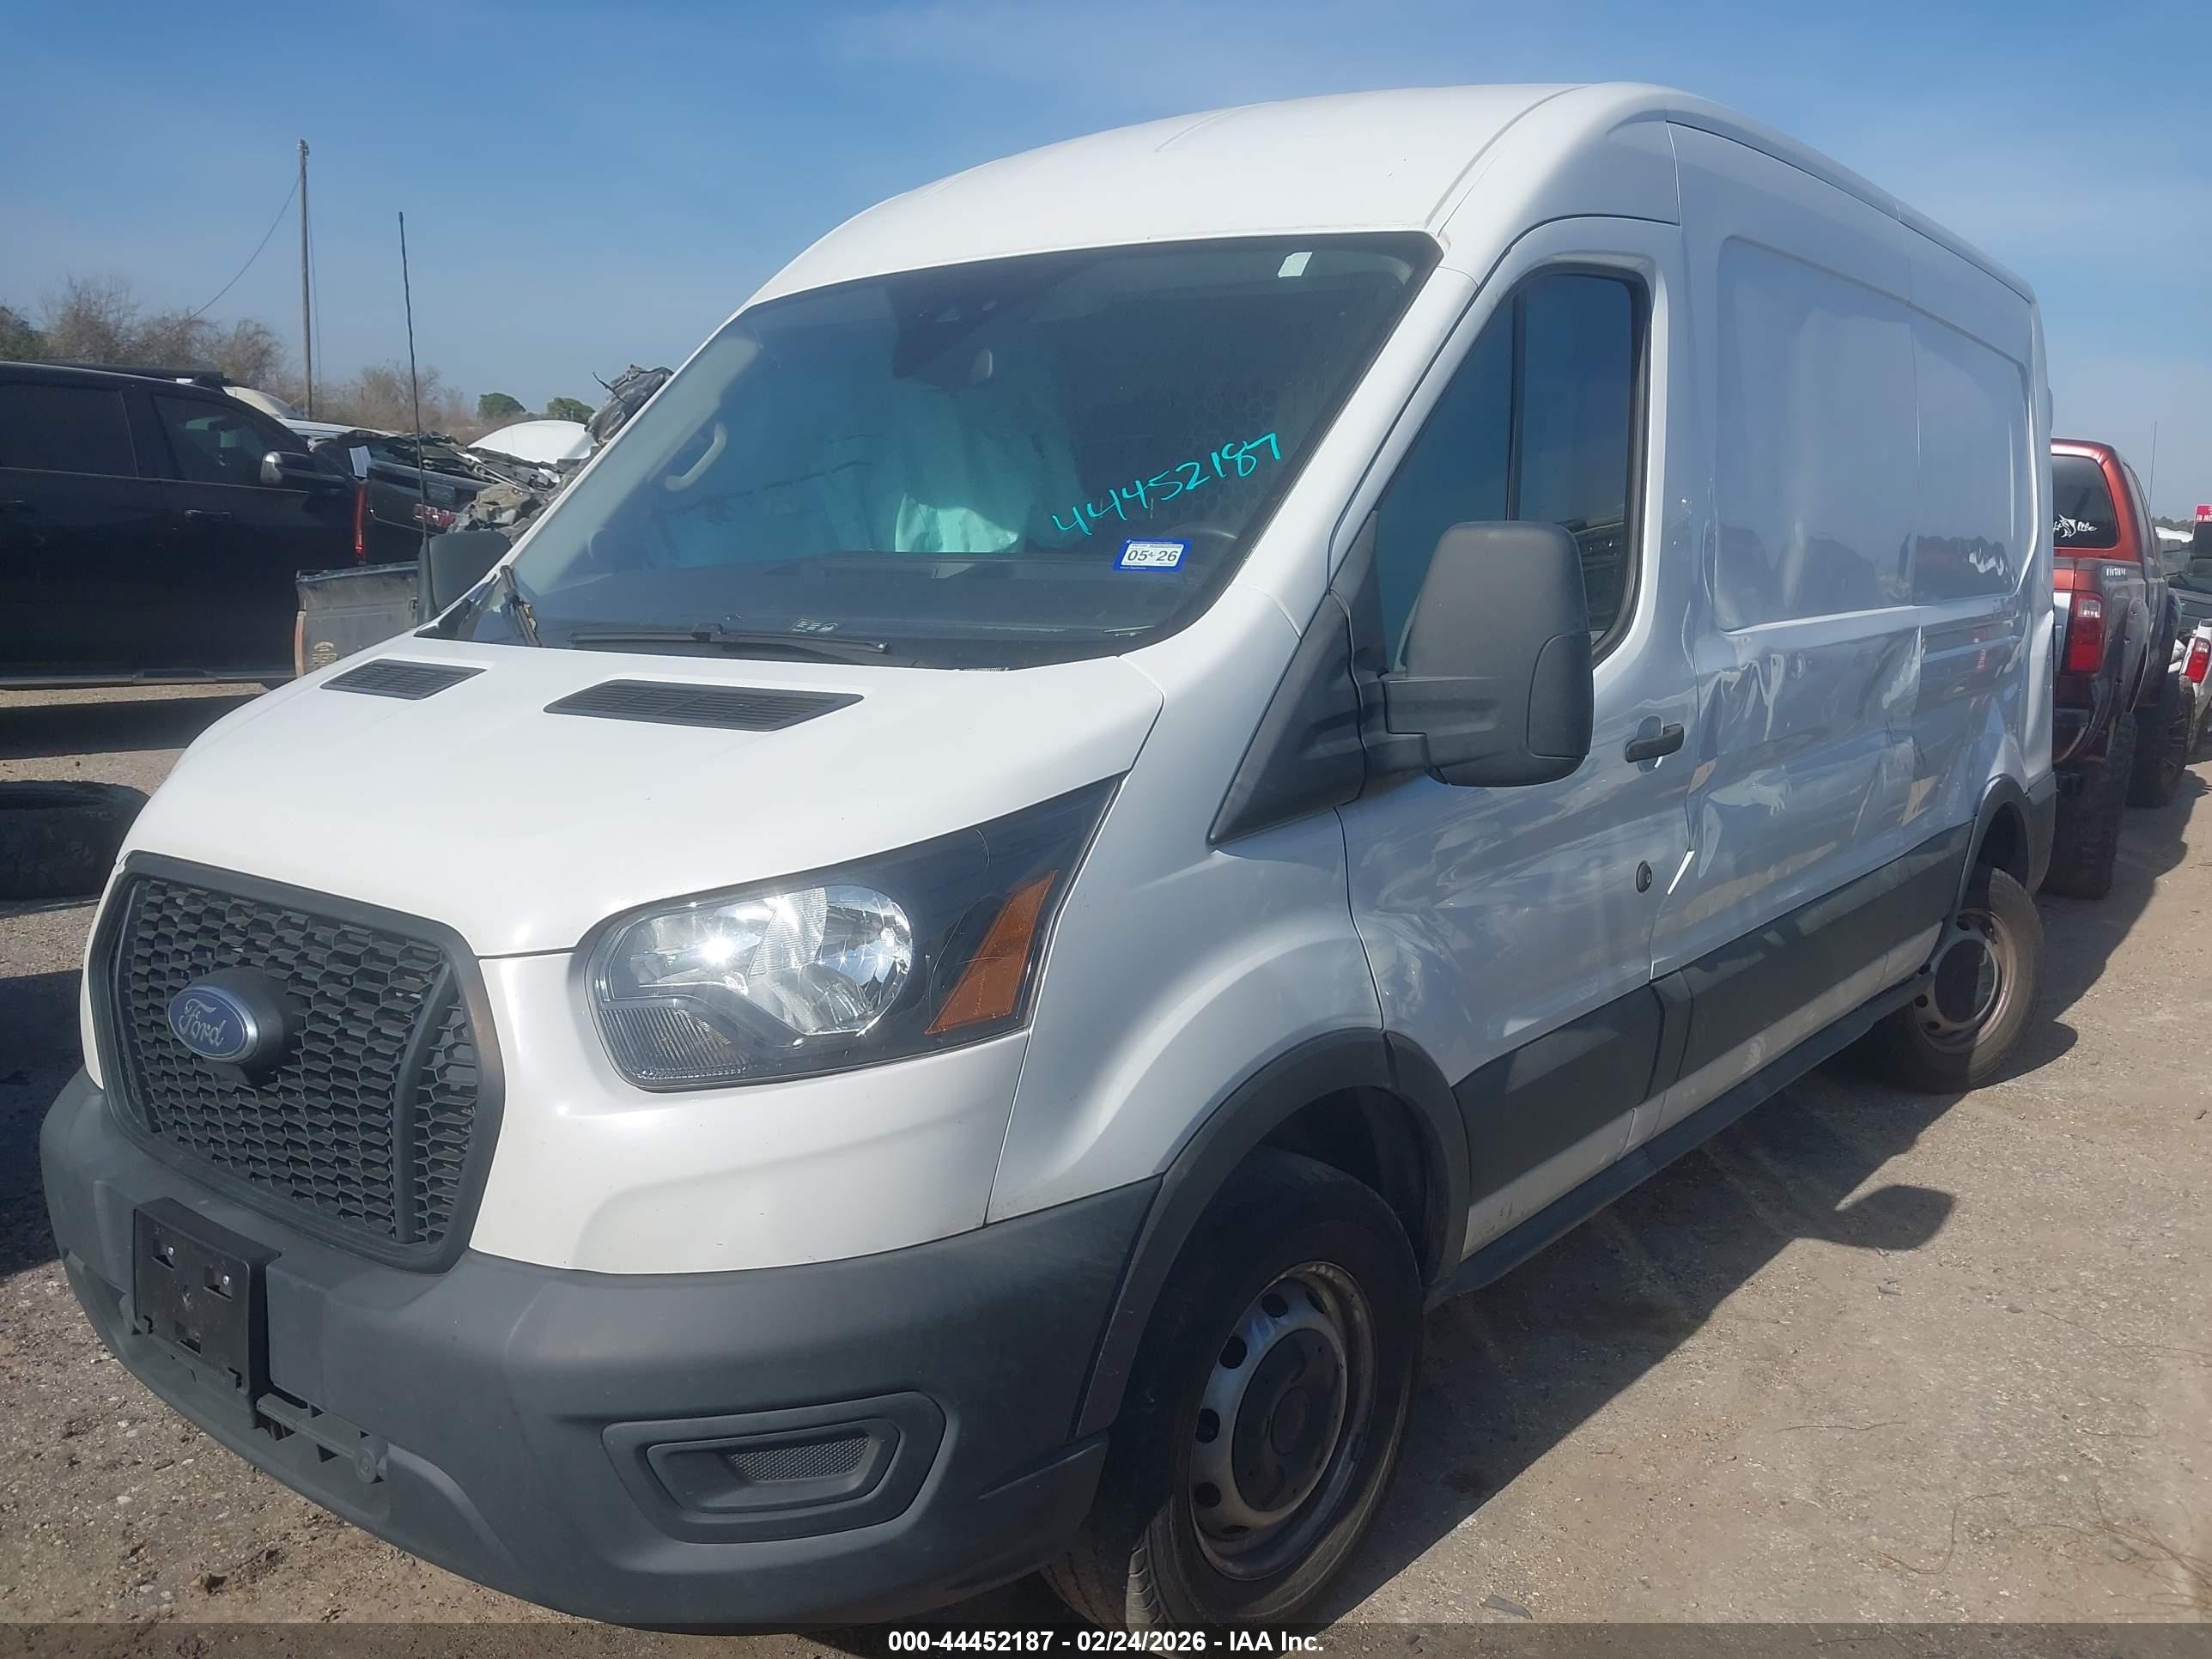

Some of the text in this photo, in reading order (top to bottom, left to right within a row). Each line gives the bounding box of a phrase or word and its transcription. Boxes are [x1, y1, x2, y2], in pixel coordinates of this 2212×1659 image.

[1051, 431, 1282, 537] 44452187
[1127, 550, 1178, 562] 05 26
[178, 998, 228, 1048] Ford
